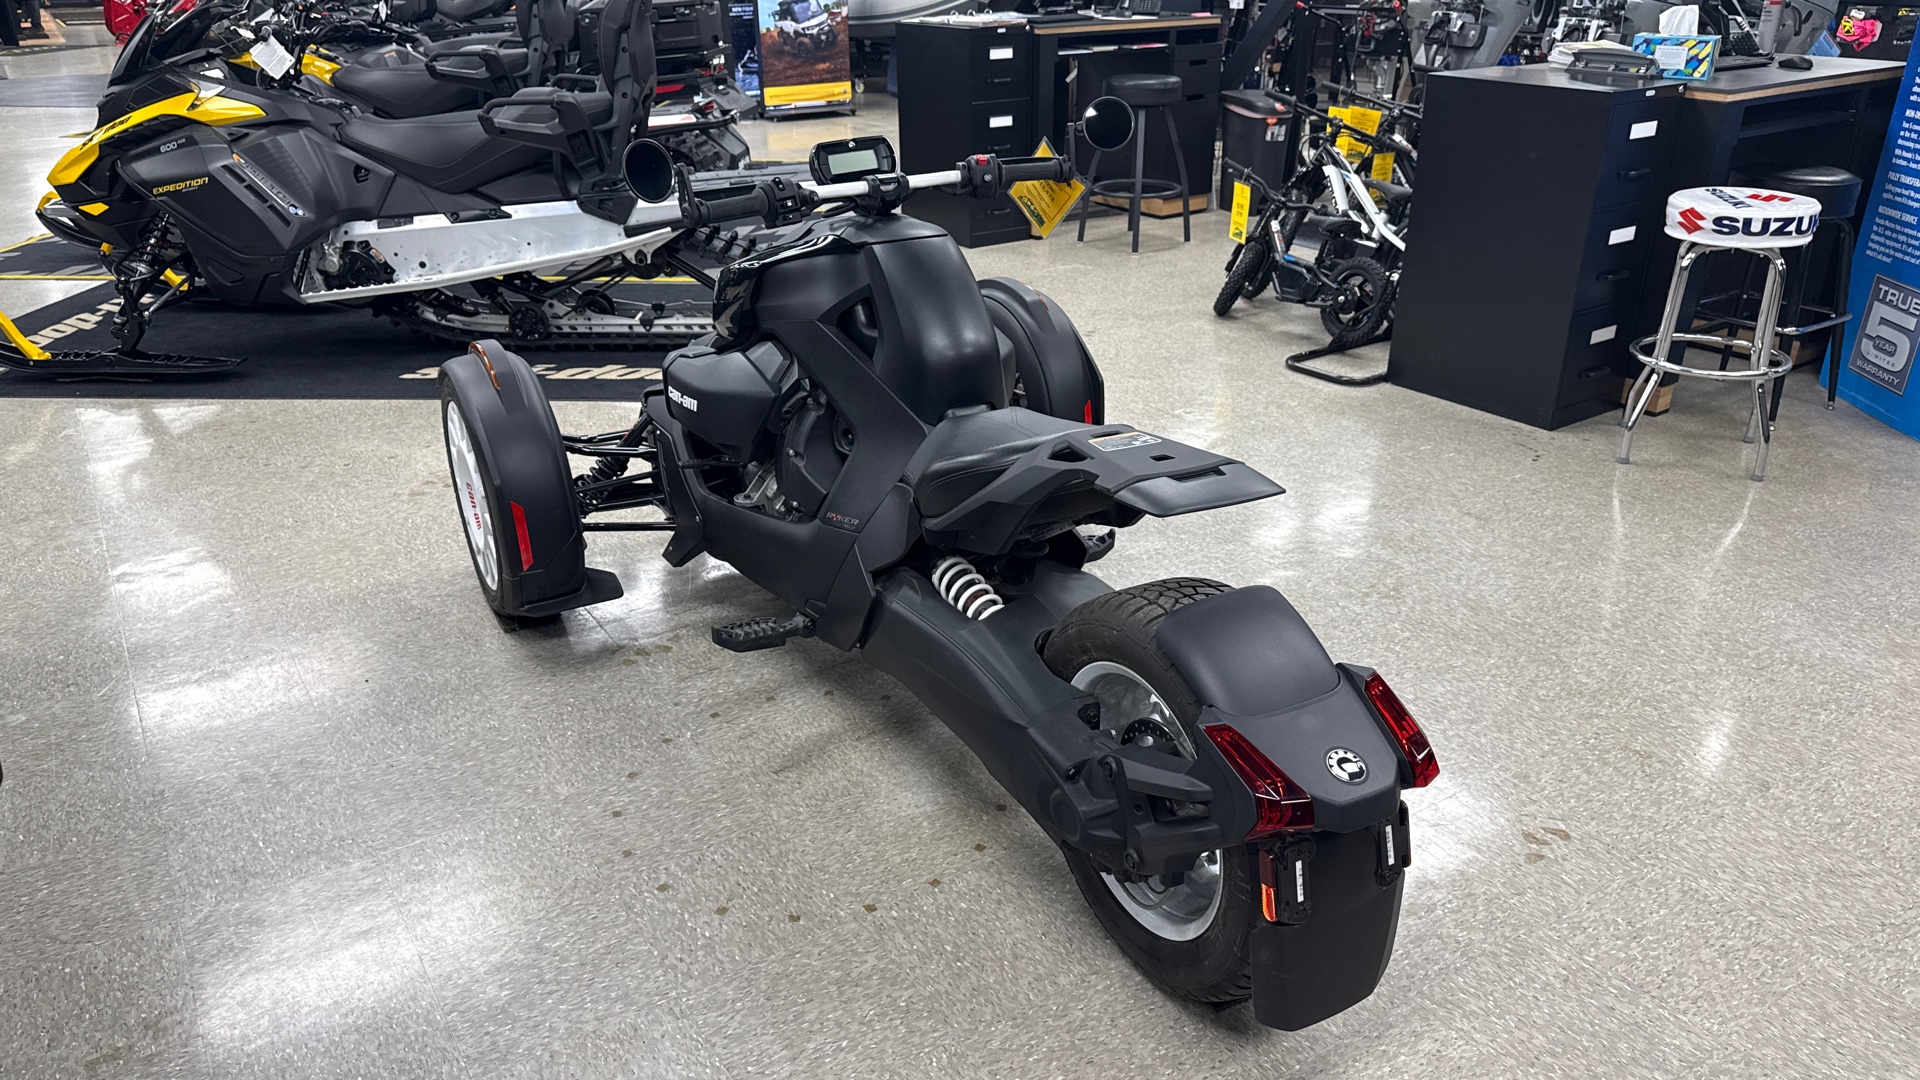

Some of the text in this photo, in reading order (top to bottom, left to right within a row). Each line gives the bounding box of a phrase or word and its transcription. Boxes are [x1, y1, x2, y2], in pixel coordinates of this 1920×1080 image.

[160, 141, 177, 153] 600
[152, 176, 209, 195] EXPEDITION
[1705, 188, 1753, 209] SUZUKI
[1878, 284, 1920, 316] TRUE
[1861, 301, 1910, 372] 5
[1874, 338, 1896, 354] YEAR
[1867, 350, 1896, 368] LIMITED
[1856, 358, 1900, 386] WARRANTY
[668, 385, 698, 412] can-am
[466, 482, 482, 530] can-am
[826, 512, 860, 526] RYKER
